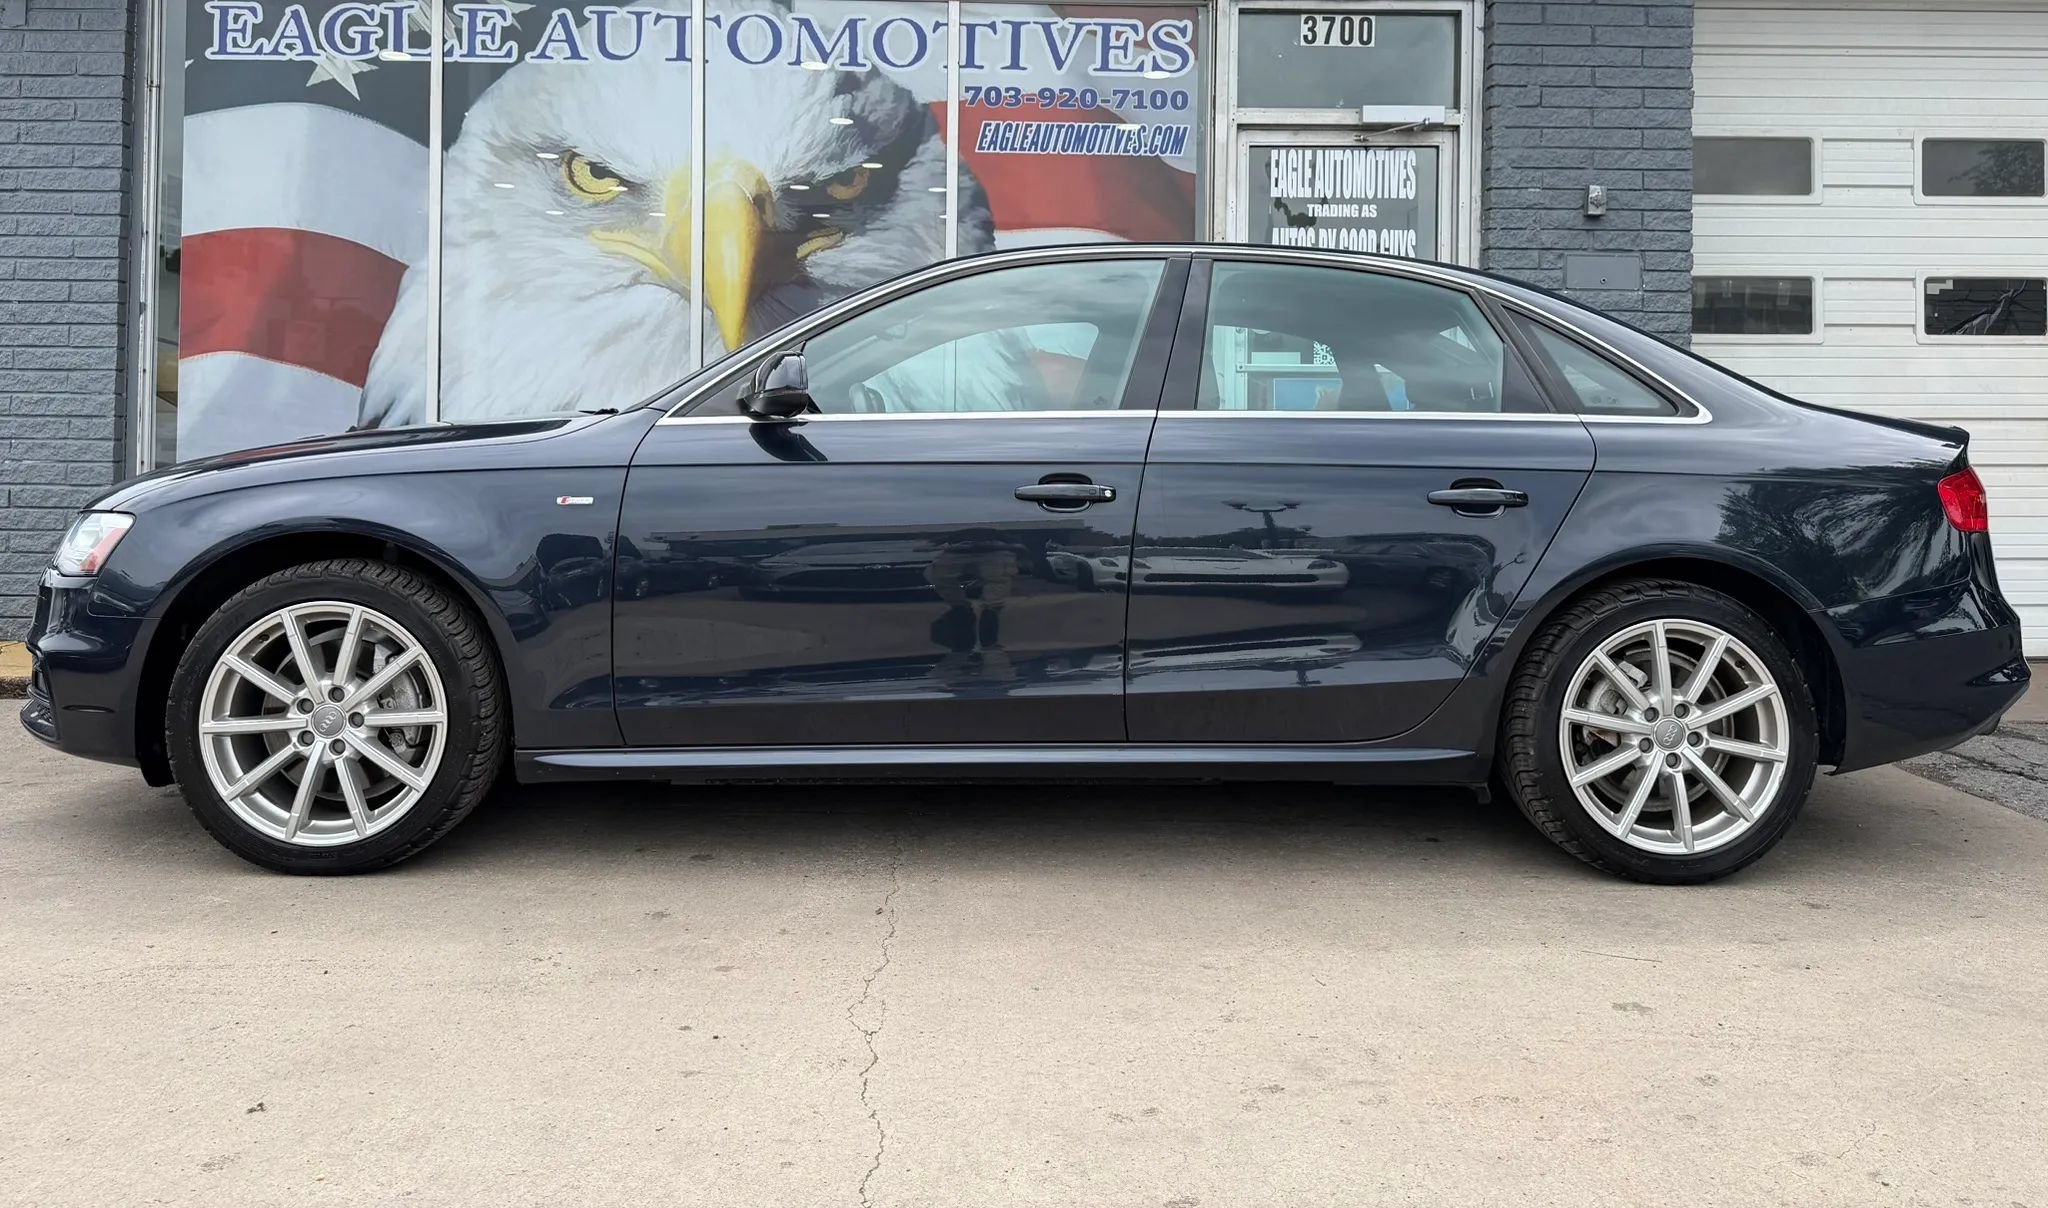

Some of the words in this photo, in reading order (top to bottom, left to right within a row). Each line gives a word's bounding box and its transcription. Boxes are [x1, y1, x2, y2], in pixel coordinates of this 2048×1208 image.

[206, 2, 517, 60] EAGLE
[526, 8, 1195, 76] AUTOMOTIVES
[1302, 15, 1373, 46] 3700
[964, 86, 1190, 110] 703-920-7100
[976, 121, 1189, 156] EAGLEAUTOMOTIVES.COM
[1270, 149, 1313, 199] EAGLE
[1314, 149, 1417, 200] AUTOMOTIVES
[1307, 203, 1359, 218] TRADING
[1361, 204, 1378, 218] AS
